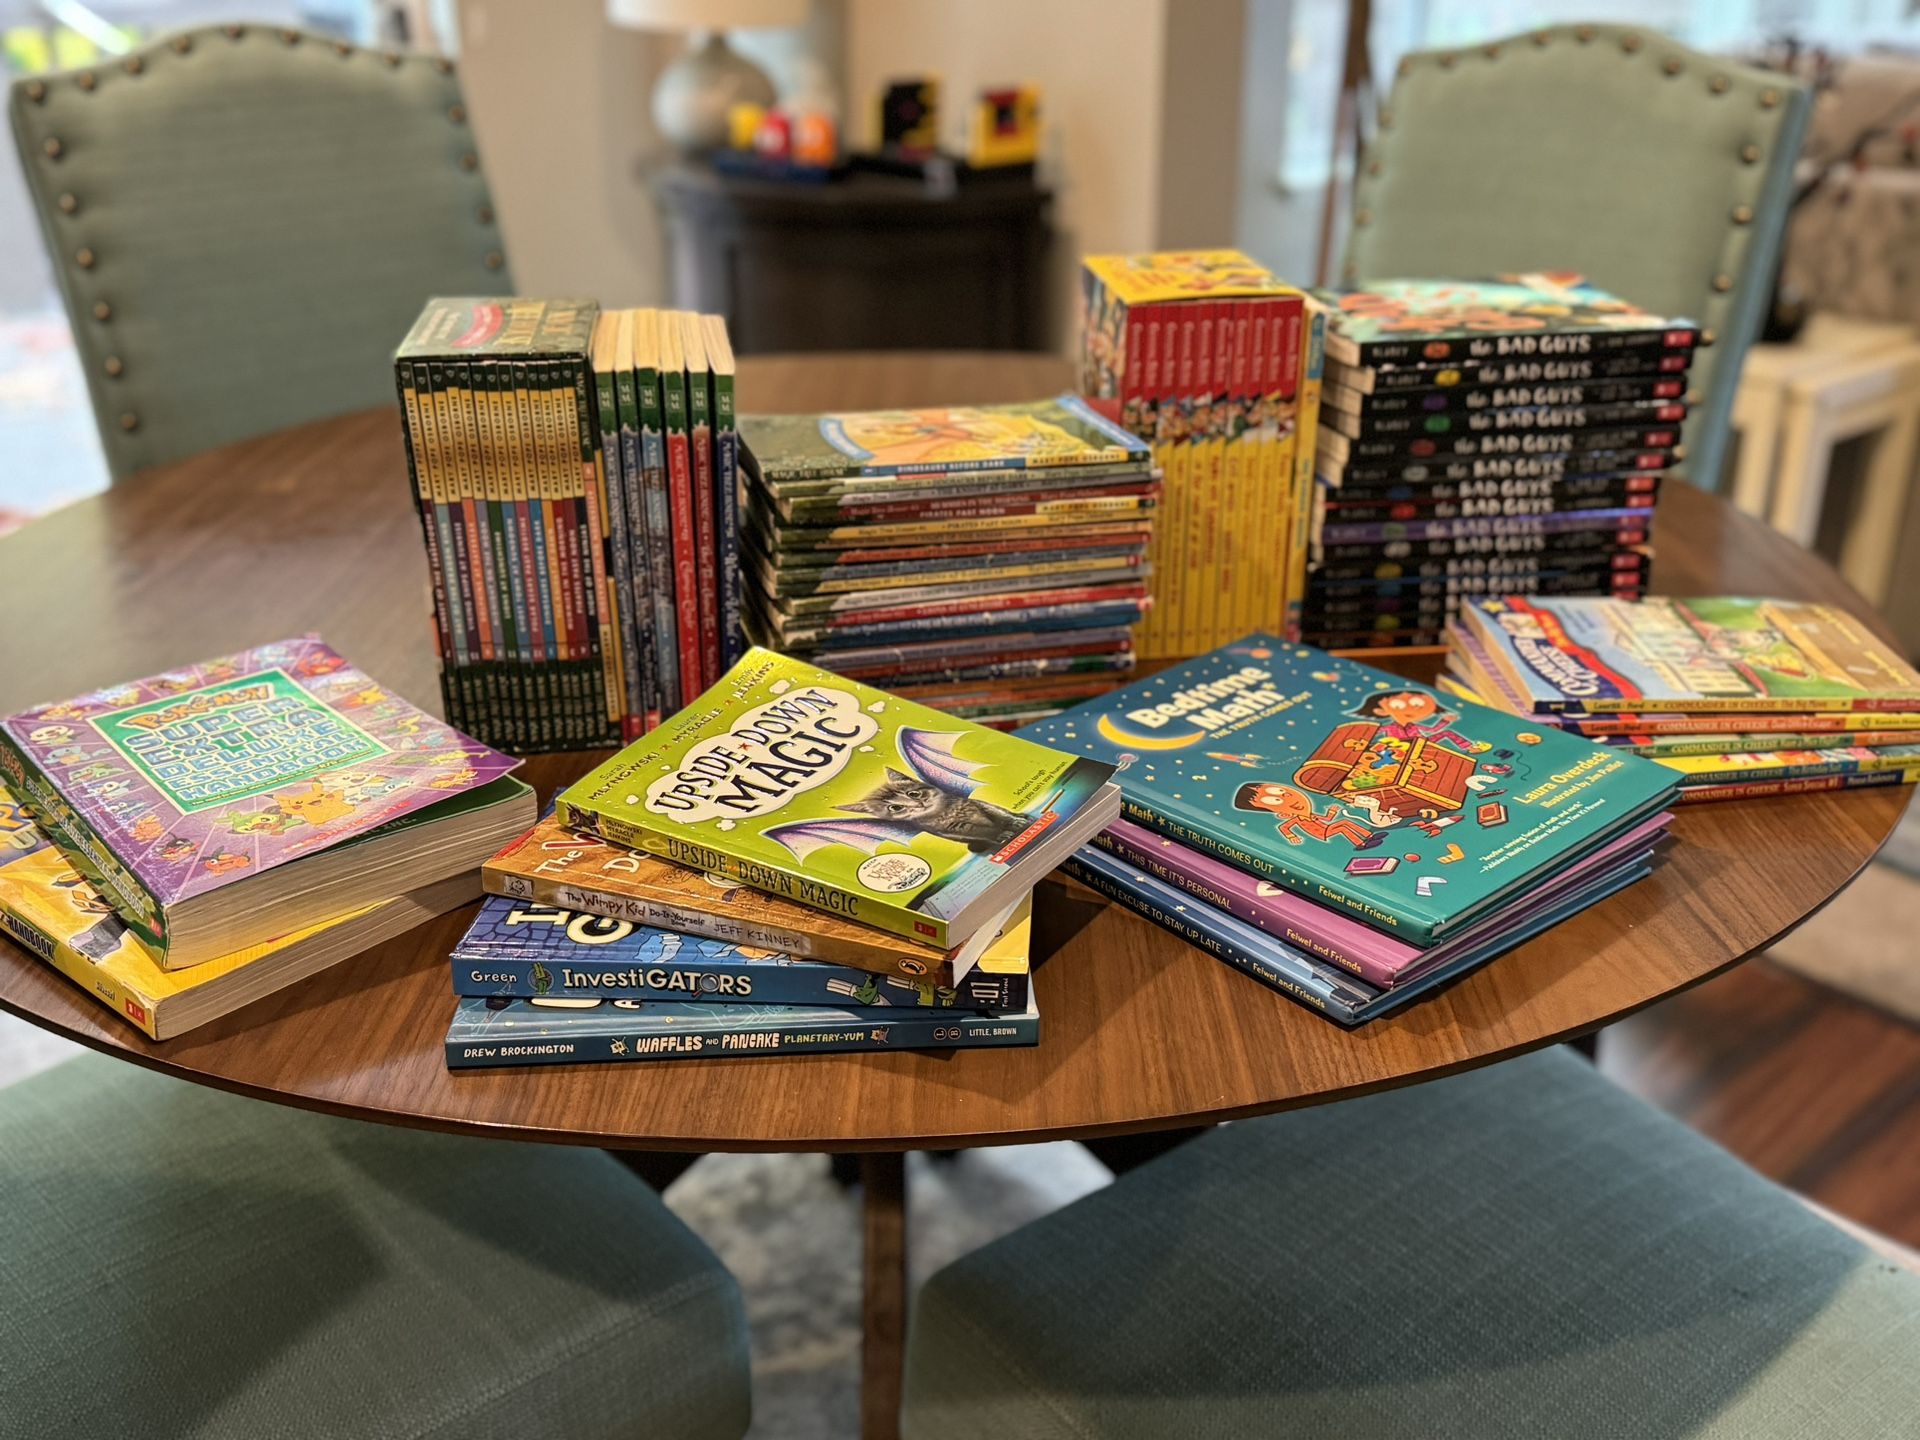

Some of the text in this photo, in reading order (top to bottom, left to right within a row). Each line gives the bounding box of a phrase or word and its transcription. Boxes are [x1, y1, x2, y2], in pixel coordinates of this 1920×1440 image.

[1498, 336, 1540, 354] BAD
[1544, 334, 1591, 353] GUYS
[1504, 362, 1539, 380] BAD
[1544, 360, 1591, 378] GUYS
[567, 396, 577, 436] OSBORNE
[1493, 388, 1530, 406] BAD
[1534, 386, 1583, 403] GUYS
[408, 397, 419, 438] OSBORNE
[451, 396, 461, 437] OSBORNE
[464, 399, 474, 439] OSBORNE
[1496, 410, 1532, 427] BAD
[1536, 408, 1586, 426] GUYS
[1481, 435, 1520, 452] BAD
[1524, 433, 1573, 451] GUYS
[1474, 459, 1512, 477] BAD
[1516, 457, 1565, 476] GUYS
[1462, 497, 1552, 515] BAD GUYS
[454, 522, 465, 557] SUNRISE
[569, 530, 577, 555] NOON
[500, 594, 511, 619] LIONS
[733, 661, 775, 699] JENKINS
[1125, 667, 1272, 729] Bedtime
[124, 697, 306, 750] SUPER
[674, 706, 724, 744] MYRACLE
[1186, 690, 1285, 730] Math
[139, 708, 328, 766] EXTRA
[152, 720, 342, 780] DELUXE
[653, 689, 839, 812] UPSIDE DOWN
[166, 732, 357, 791] ESSENTIAL
[176, 740, 371, 801] HANDBOOK
[589, 751, 660, 802] Sarah MLYNOWSKI
[714, 716, 861, 814] MAGIC
[1512, 751, 1612, 805] Laura Overdeck
[605, 818, 643, 836] MLYNOWSKI
[605, 825, 635, 840] MYRACLE
[605, 831, 632, 845] JENKINS
[1001, 812, 1057, 858] SCHOLASTIC
[1128, 804, 1274, 874] Math THE TRUTH COMES OUT
[533, 848, 583, 876] The
[667, 838, 728, 873] UPSIDE
[738, 860, 794, 895] DOWN
[799, 879, 859, 916] MAGIC
[1127, 849, 1145, 865] THIS
[1148, 858, 1167, 876] TIME
[1169, 868, 1185, 885] IT'S
[1187, 880, 1232, 909] PERSONAL
[565, 891, 581, 903] The
[580, 895, 624, 917] Wimpy
[625, 900, 646, 917] Kid
[1092, 875, 1099, 885] A
[1101, 881, 1116, 896] FUN
[1118, 890, 1149, 914] EXCUSE
[1151, 907, 1163, 921] TO
[1164, 915, 1184, 933] STAY
[1186, 927, 1199, 939] UP
[1201, 934, 1221, 953] LATE
[1318, 885, 1397, 926] Feiwel and Friends
[9, 917, 54, 962] HANDBOOK
[713, 923, 800, 949] JEFF KINNEY
[1286, 928, 1362, 973] Feiwel and Friends
[470, 968, 752, 996] Green InvestiGATORS
[1253, 962, 1325, 1009] Feiwel and Friends
[464, 1031, 865, 1058] DREW BROCKINGTON WAFFLES AND PANCAKE PLANETARY-YUM
[969, 1027, 1017, 1038] LITTLE, BROWN
